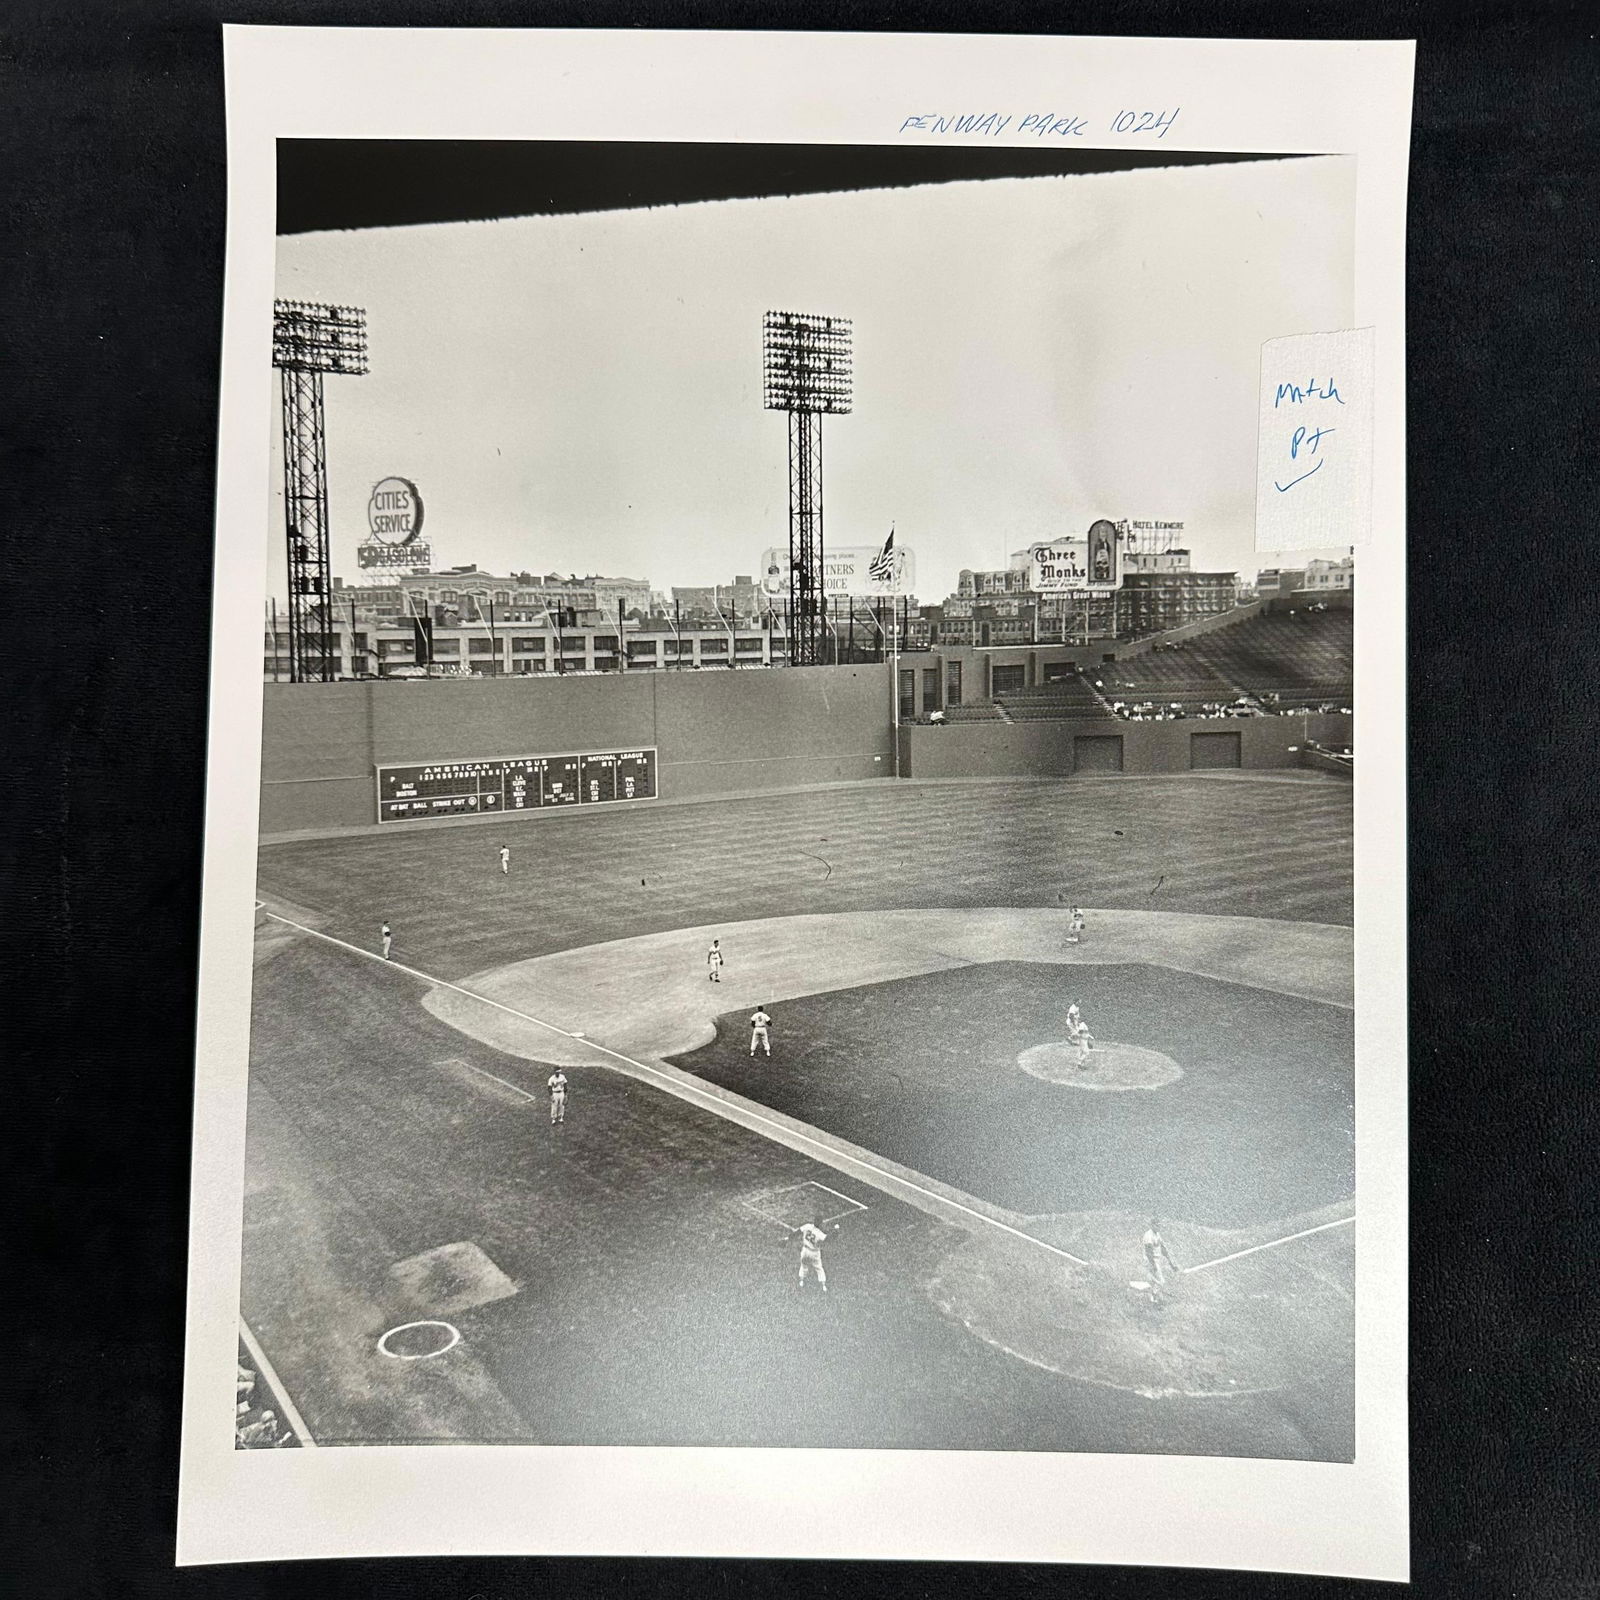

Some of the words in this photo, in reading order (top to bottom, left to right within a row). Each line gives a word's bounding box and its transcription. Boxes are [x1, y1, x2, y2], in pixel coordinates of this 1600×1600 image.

[899, 113, 1012, 136] FENWAY
[1018, 113, 1089, 136] PARK
[1110, 107, 1181, 139] 1024
[374, 490, 410, 511] CITIES
[374, 513, 412, 534] SERVICE
[1132, 520, 1153, 530] HOTEL
[1034, 547, 1076, 563] Three
[1040, 563, 1086, 582] Monks
[588, 754, 617, 762] NATIONAL
[620, 752, 643, 760] LEAGUE
[424, 763, 490, 774] AMERICAN
[502, 759, 548, 768] LEAGUE
[432, 800, 451, 808] STRIKE
[453, 798, 466, 806] OUT
